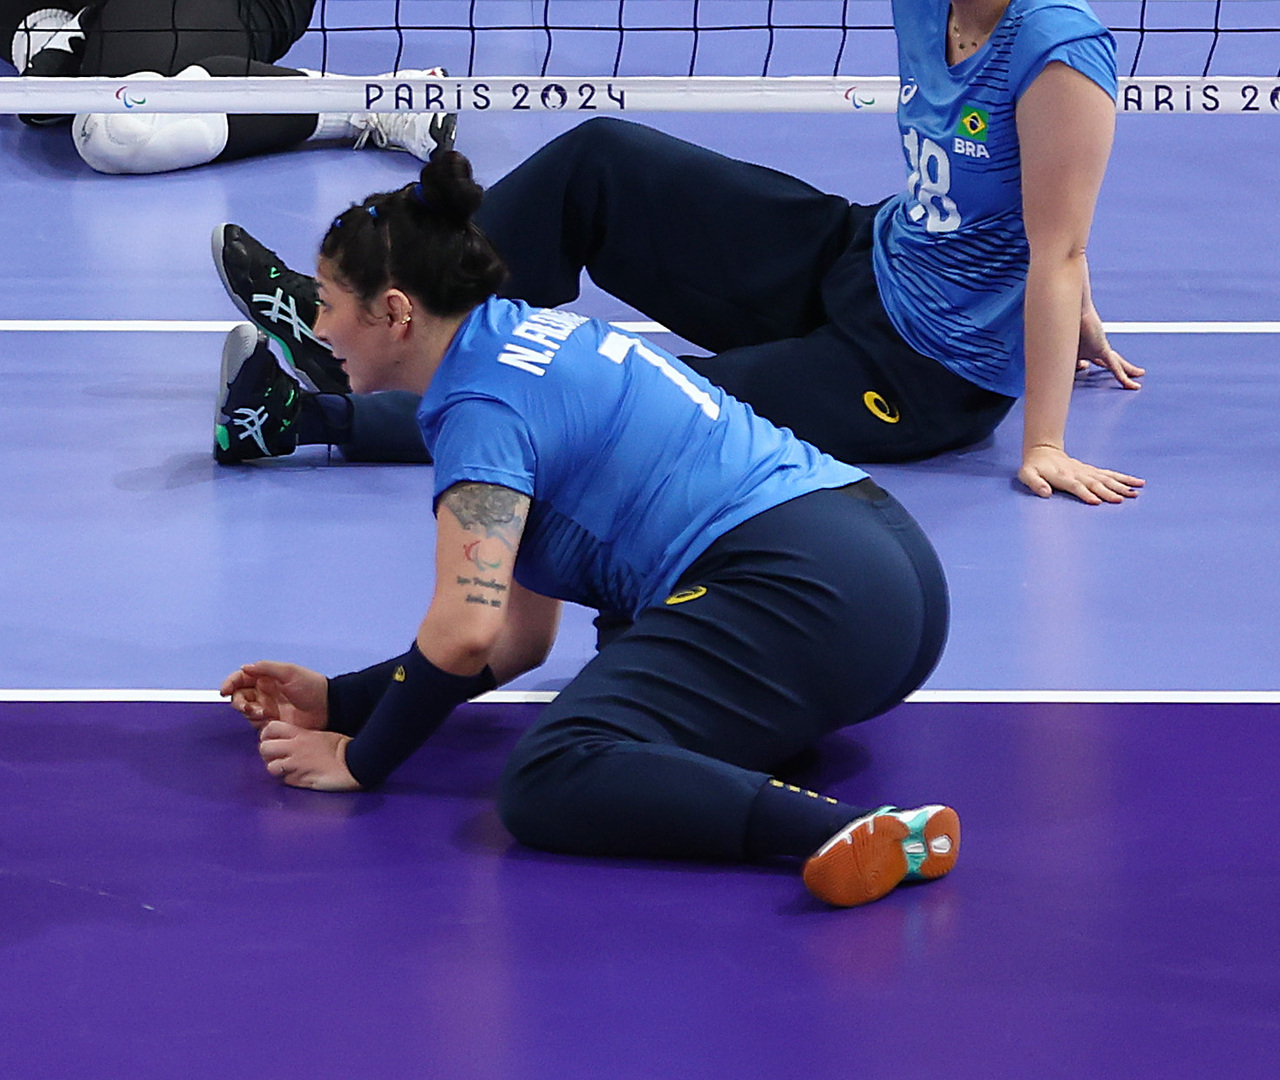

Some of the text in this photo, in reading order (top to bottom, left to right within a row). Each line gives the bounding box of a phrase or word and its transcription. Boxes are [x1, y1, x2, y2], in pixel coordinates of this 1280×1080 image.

[511, 82, 626, 110] 2024
[1123, 83, 1220, 112] ARiS
[952, 137, 990, 159] BRA
[903, 126, 962, 233] 18
[597, 330, 722, 421] 7
